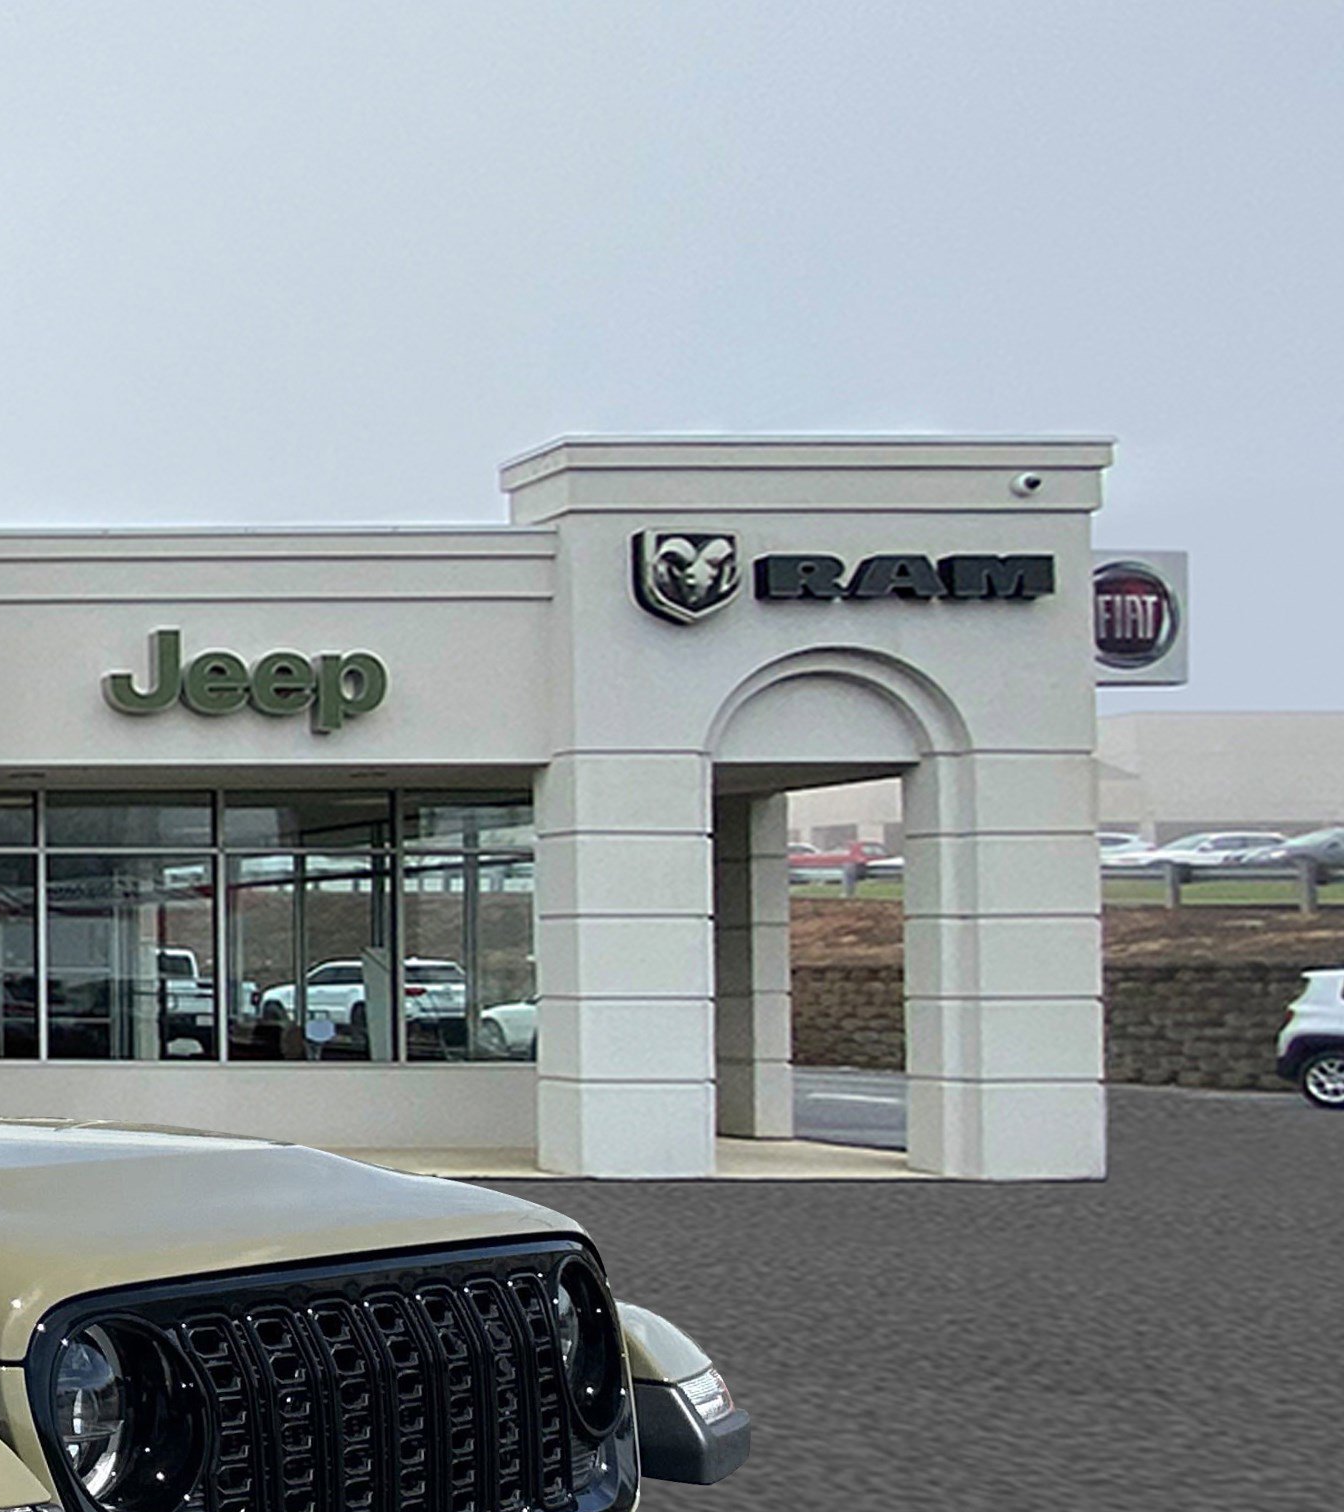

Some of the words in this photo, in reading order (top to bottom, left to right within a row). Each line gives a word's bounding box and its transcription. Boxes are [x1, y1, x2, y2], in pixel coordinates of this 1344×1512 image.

[754, 552, 1056, 602] RAM
[1097, 594, 1158, 640] FIAT
[102, 626, 389, 735] Jeep
